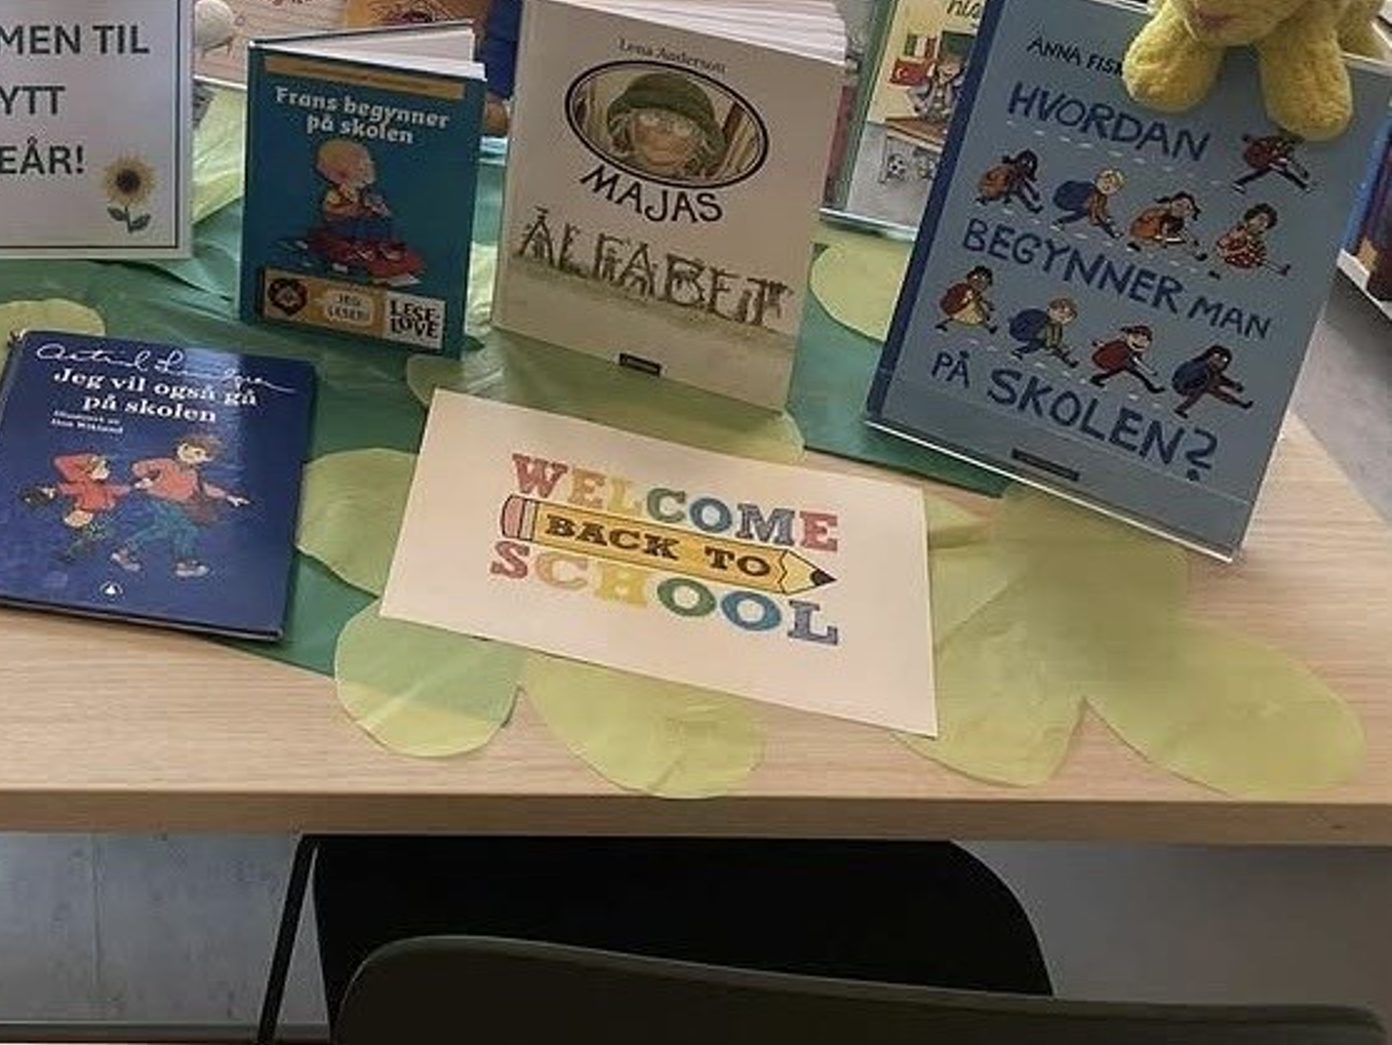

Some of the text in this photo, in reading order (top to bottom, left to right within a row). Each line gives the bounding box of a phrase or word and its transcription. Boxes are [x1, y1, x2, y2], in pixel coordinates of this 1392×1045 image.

[92, 24, 150, 55] TIL
[1026, 35, 1080, 67] ANNA
[274, 85, 451, 129] Frans begynner
[307, 113, 415, 145] på skolen
[1007, 81, 1210, 162] HVORDAN
[580, 164, 724, 224] MAJAS
[962, 218, 1273, 340] BEGYNNER MAN
[53, 368, 257, 407] Jeg vil også gå
[82, 393, 217, 423] på skolen
[931, 349, 972, 390] PÅ
[986, 368, 1219, 483] SKOLEN?
[511, 452, 839, 553] WELCOME
[544, 512, 772, 578] BACK TO
[489, 539, 840, 646] SCHOOL
